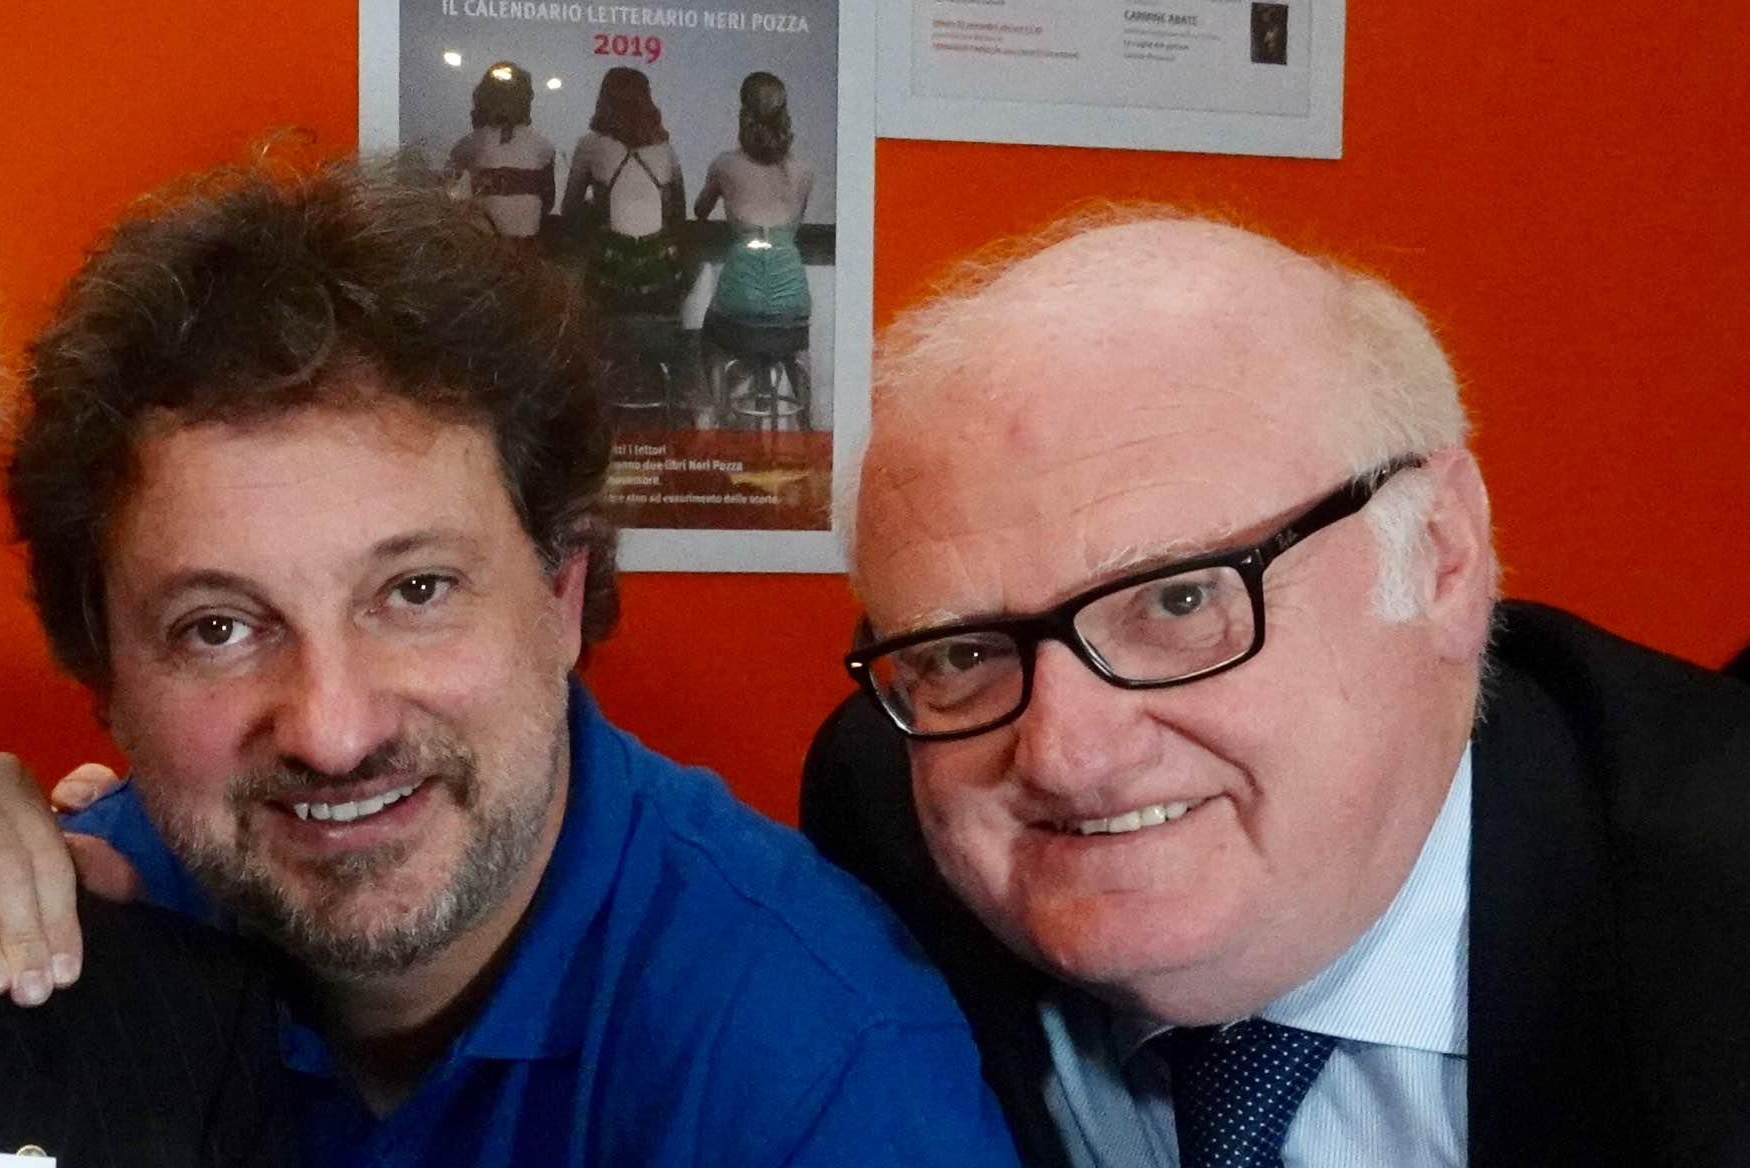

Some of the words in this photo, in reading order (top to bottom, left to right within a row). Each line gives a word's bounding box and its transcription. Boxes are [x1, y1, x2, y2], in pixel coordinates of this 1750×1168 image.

[464, 0, 581, 22] CALENDARIO
[587, 5, 698, 28] LETTERARIO
[704, 11, 745, 29] NERI
[752, 13, 809, 33] POZZA
[594, 34, 662, 64] 2019
